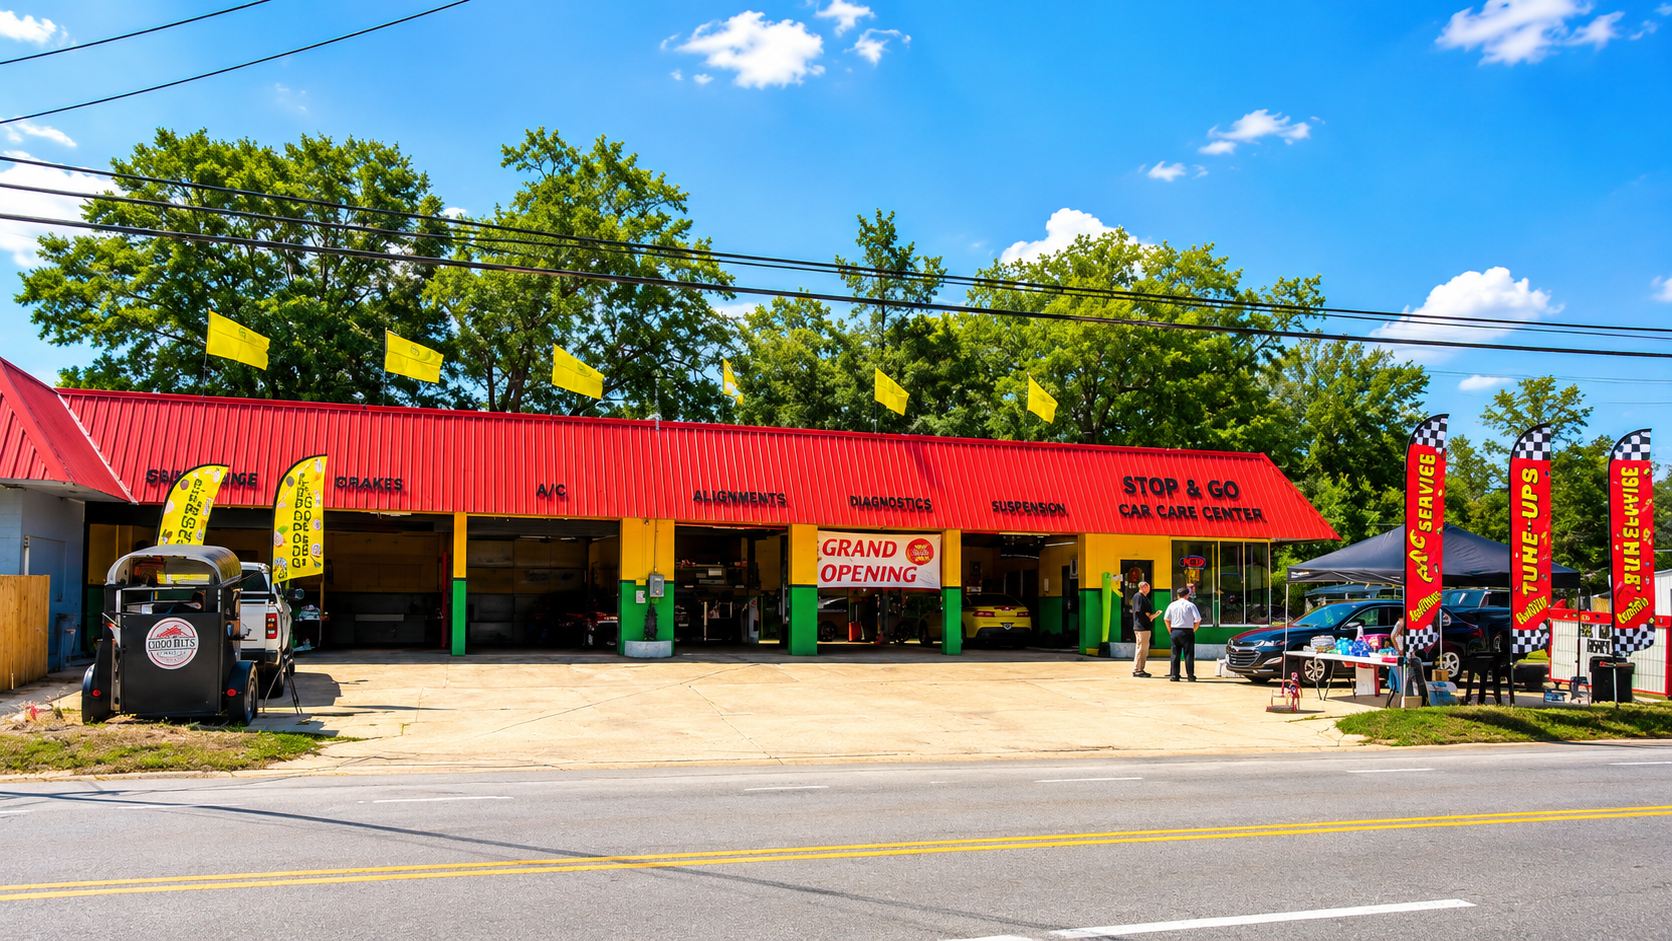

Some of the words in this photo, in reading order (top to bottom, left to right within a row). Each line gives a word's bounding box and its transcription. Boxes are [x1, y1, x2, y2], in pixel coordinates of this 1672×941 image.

[536, 484, 566, 497] A/C
[1123, 476, 1178, 496] STOP
[1187, 479, 1202, 498] &
[1207, 480, 1240, 499] GO
[693, 490, 787, 507] ALIGNMENTS
[850, 495, 932, 511] DIAGNOSTICS
[992, 500, 1067, 515] SUSPENSION
[1119, 504, 1152, 519] CAR
[1156, 505, 1198, 520] CARE
[1202, 506, 1265, 523] CENTER
[822, 538, 898, 558] GRAND
[820, 564, 918, 583] OPENING
